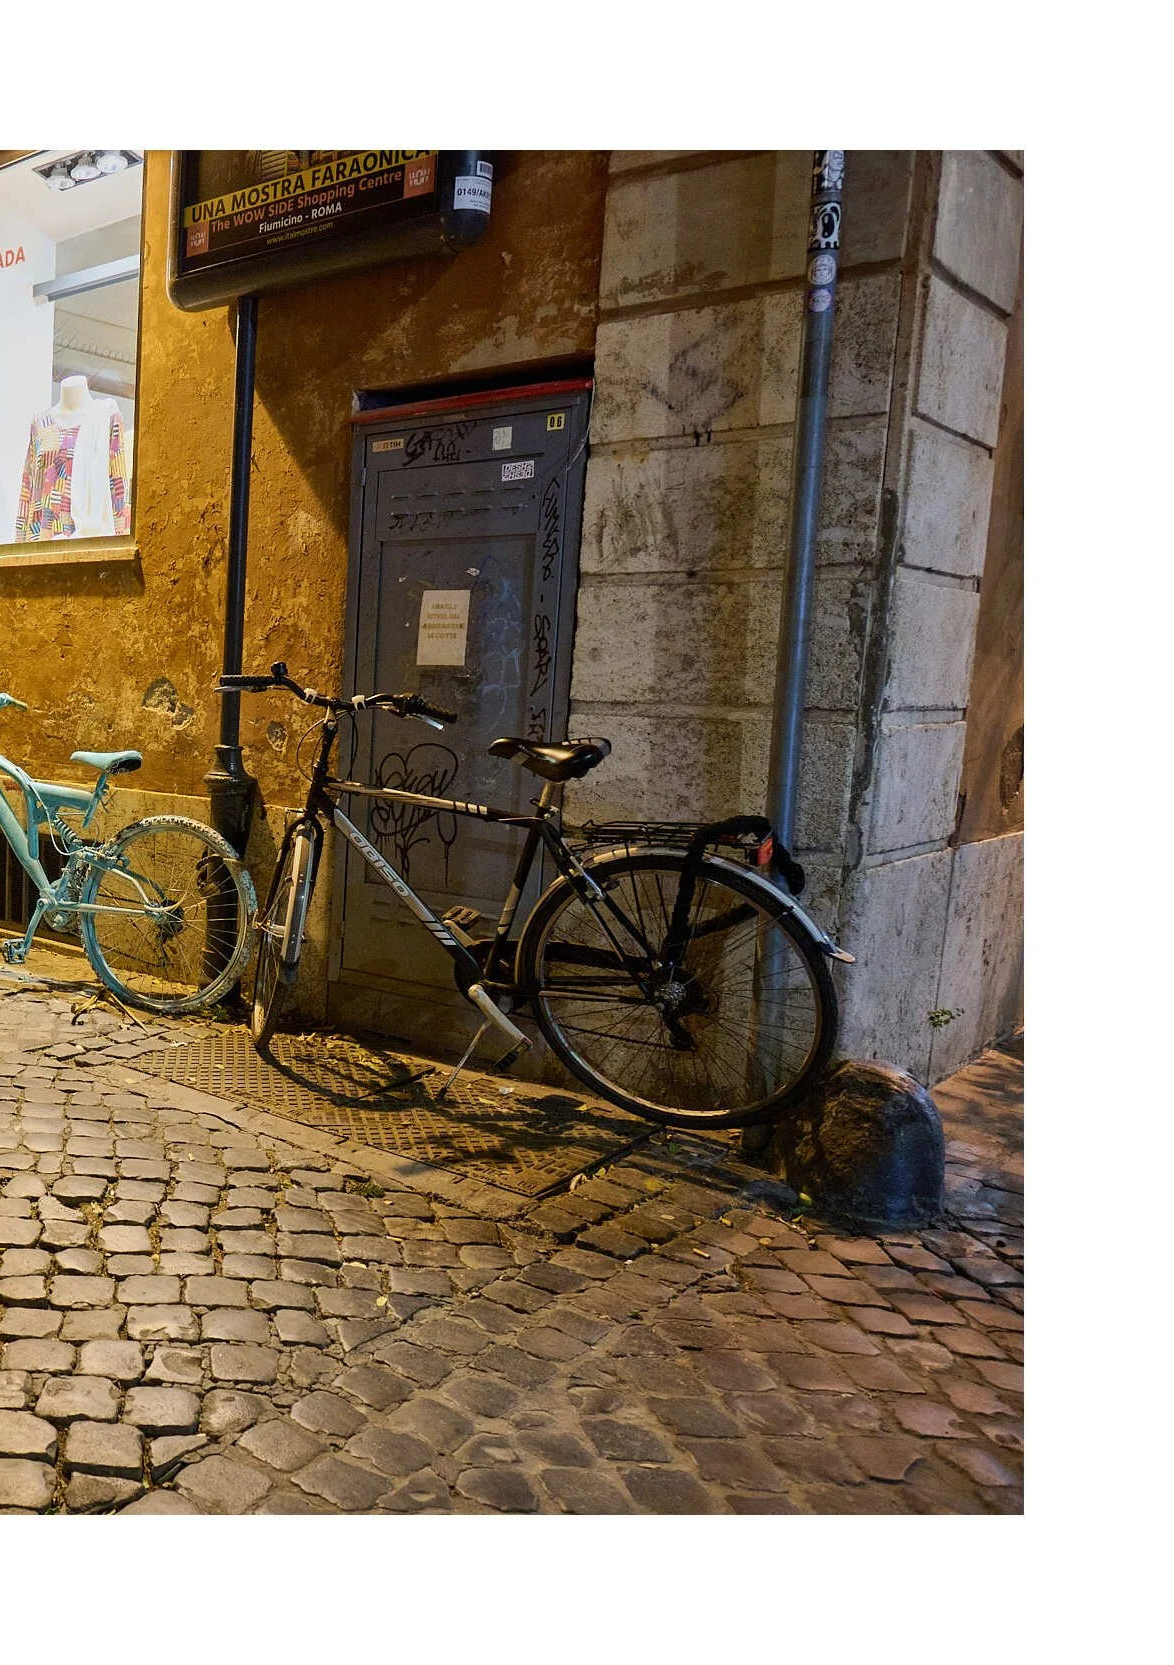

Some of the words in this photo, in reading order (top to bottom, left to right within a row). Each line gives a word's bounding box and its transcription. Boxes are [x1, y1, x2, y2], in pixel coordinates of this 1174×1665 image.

[192, 199, 226, 223] UNA
[231, 174, 305, 211] MOSTRA
[211, 219, 230, 233] The
[233, 206, 266, 227] WOW
[268, 199, 294, 217] SIDE
[297, 184, 355, 209] Shopping
[358, 170, 403, 191] Centre
[259, 214, 303, 233] Fiumicino
[311, 202, 343, 220] ROMA
[549, 416, 562, 428] 06
